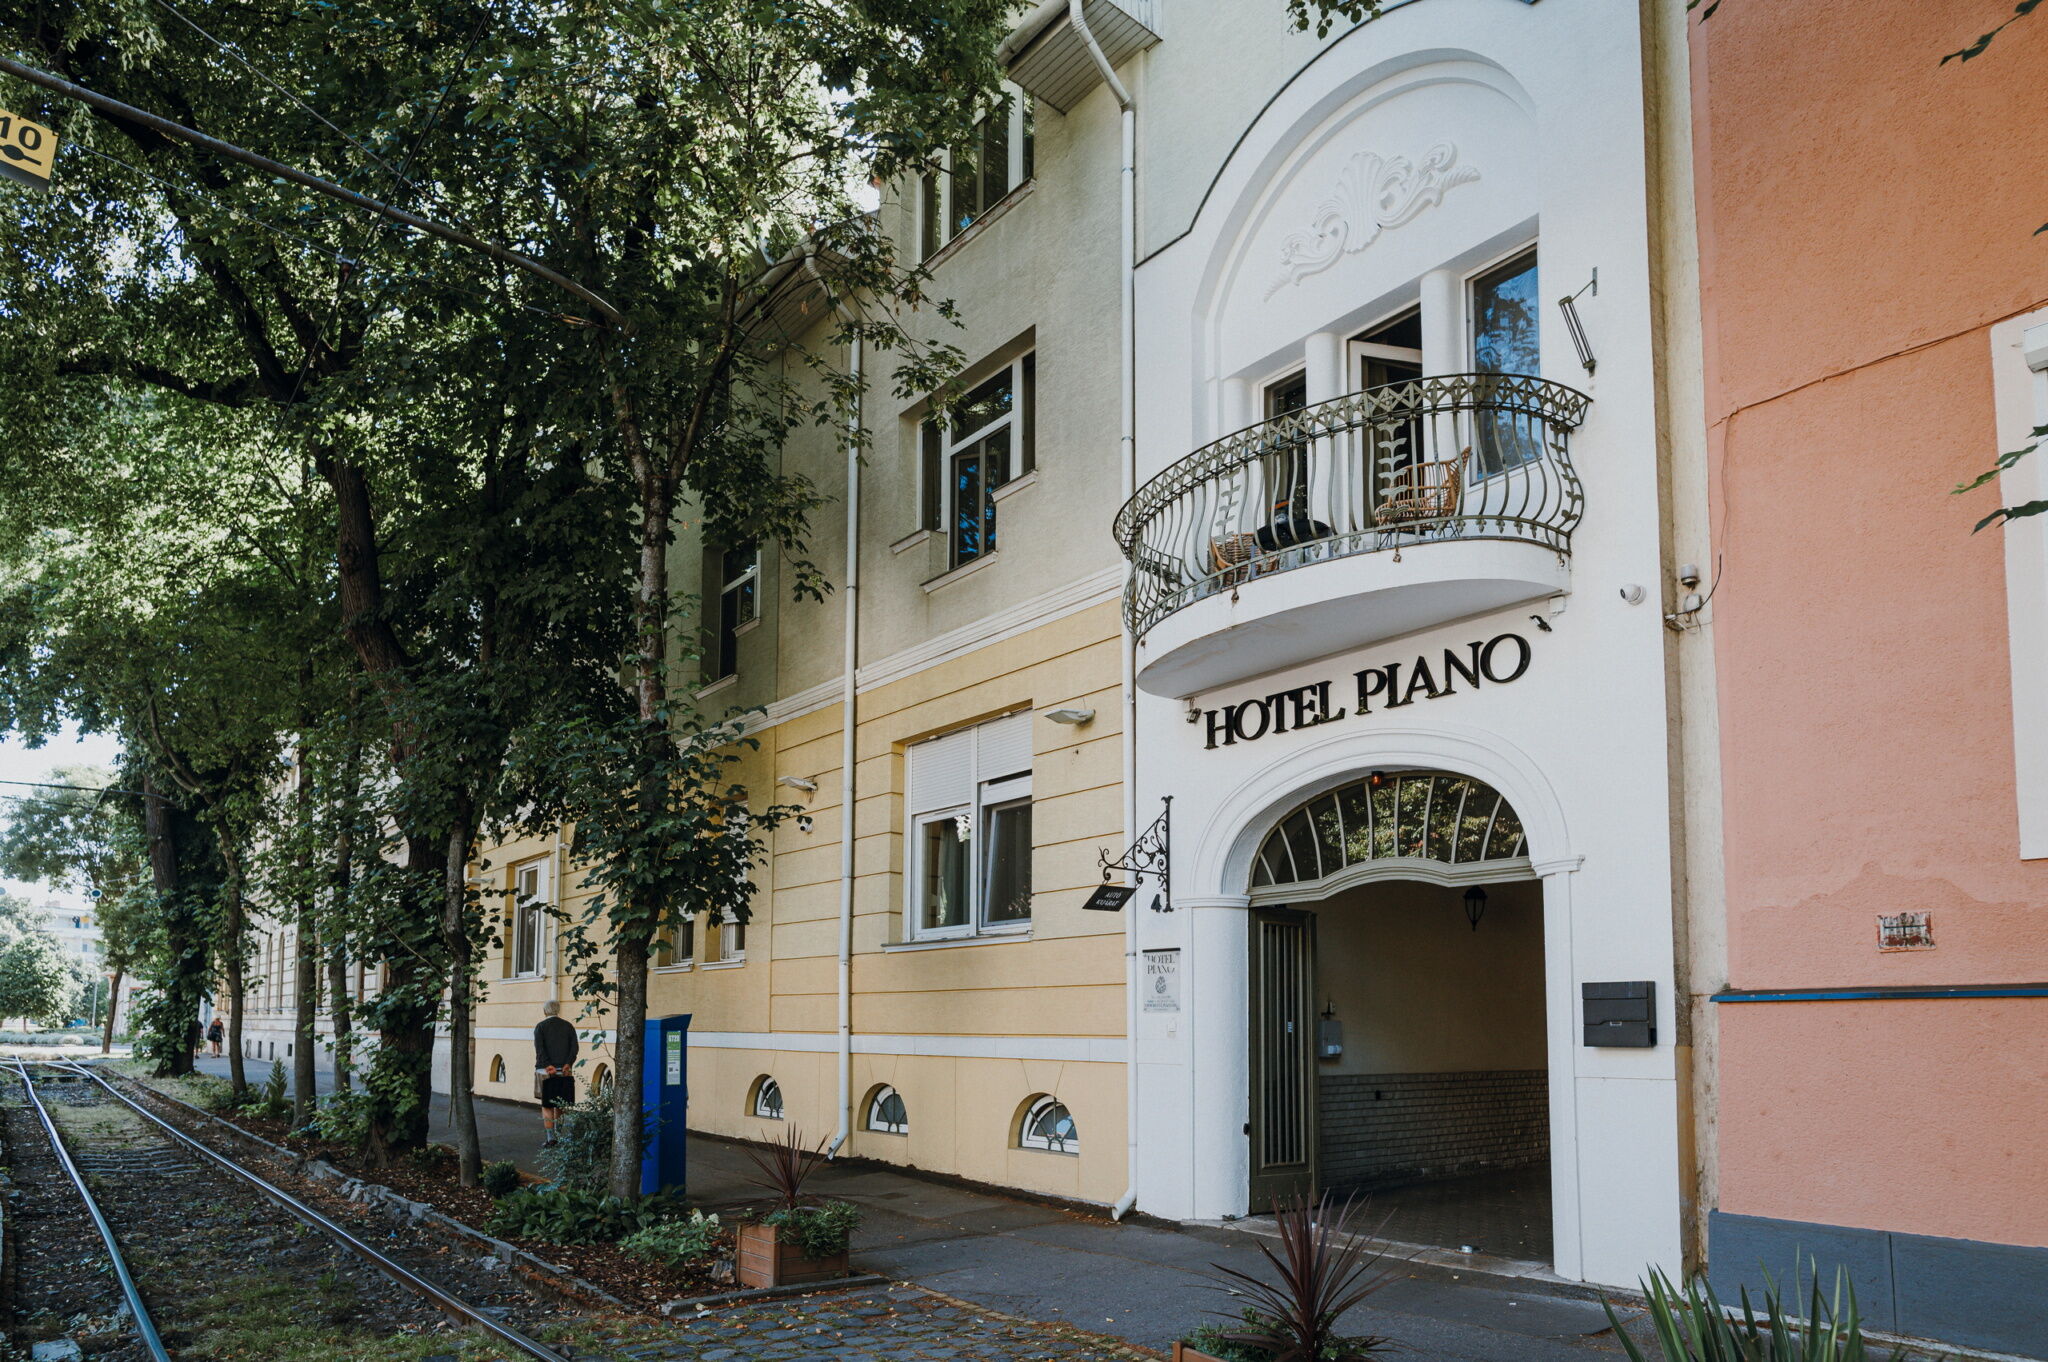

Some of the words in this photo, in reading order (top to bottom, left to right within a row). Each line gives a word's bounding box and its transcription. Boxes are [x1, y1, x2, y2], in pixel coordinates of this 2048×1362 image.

[0, 116, 42, 151] 10
[1204, 680, 1345, 750] HOTEL
[1353, 633, 1531, 715] PIANO
[1150, 893, 1162, 913] 4
[1147, 954, 1175, 963] HOTEL
[1147, 964, 1175, 974] PIANO
